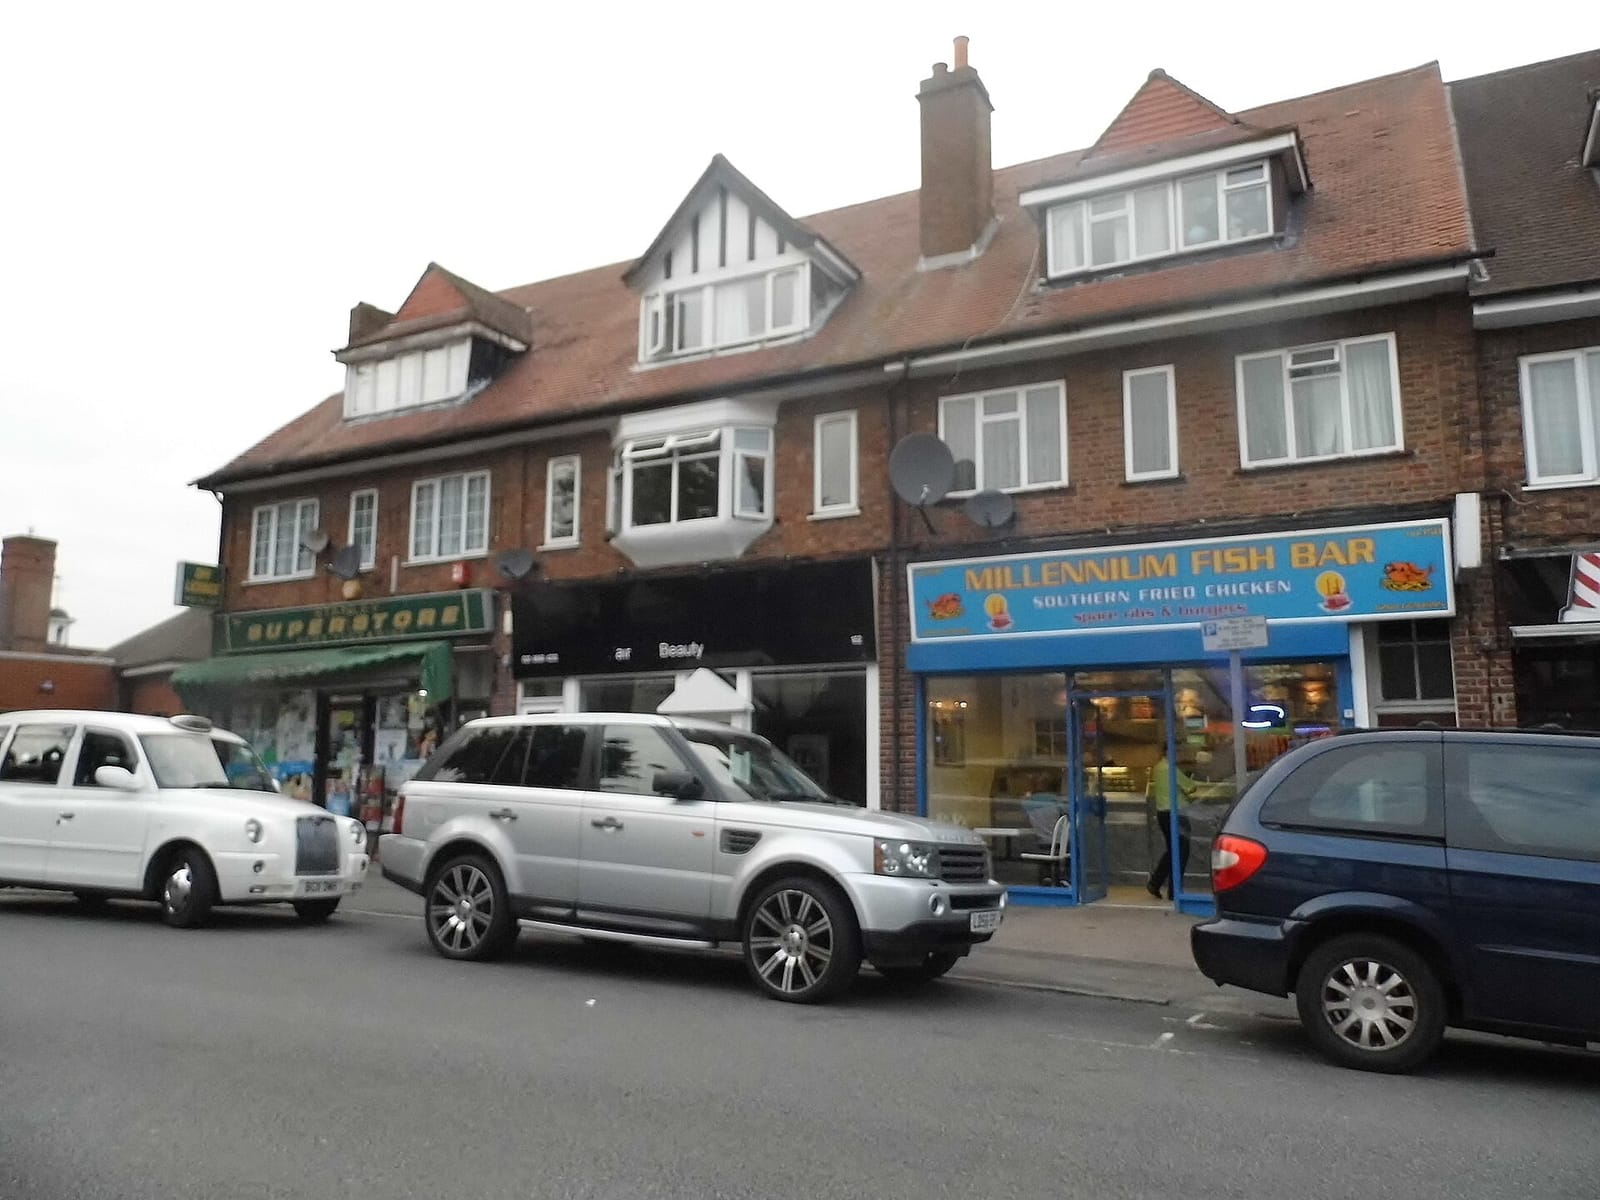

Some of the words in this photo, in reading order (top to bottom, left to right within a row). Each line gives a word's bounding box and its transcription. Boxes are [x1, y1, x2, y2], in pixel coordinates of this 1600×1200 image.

[965, 553, 1178, 591] MILLENNIUM
[1191, 545, 1276, 575] FISH
[1290, 538, 1376, 568] BAR
[1033, 590, 1130, 609] SOUTHERN
[1139, 586, 1195, 601] FRIED
[1206, 580, 1292, 598] CHICKEN
[247, 605, 460, 642] SUPERSTORE
[1161, 606, 1171, 617] &
[658, 642, 705, 660] Beauty
